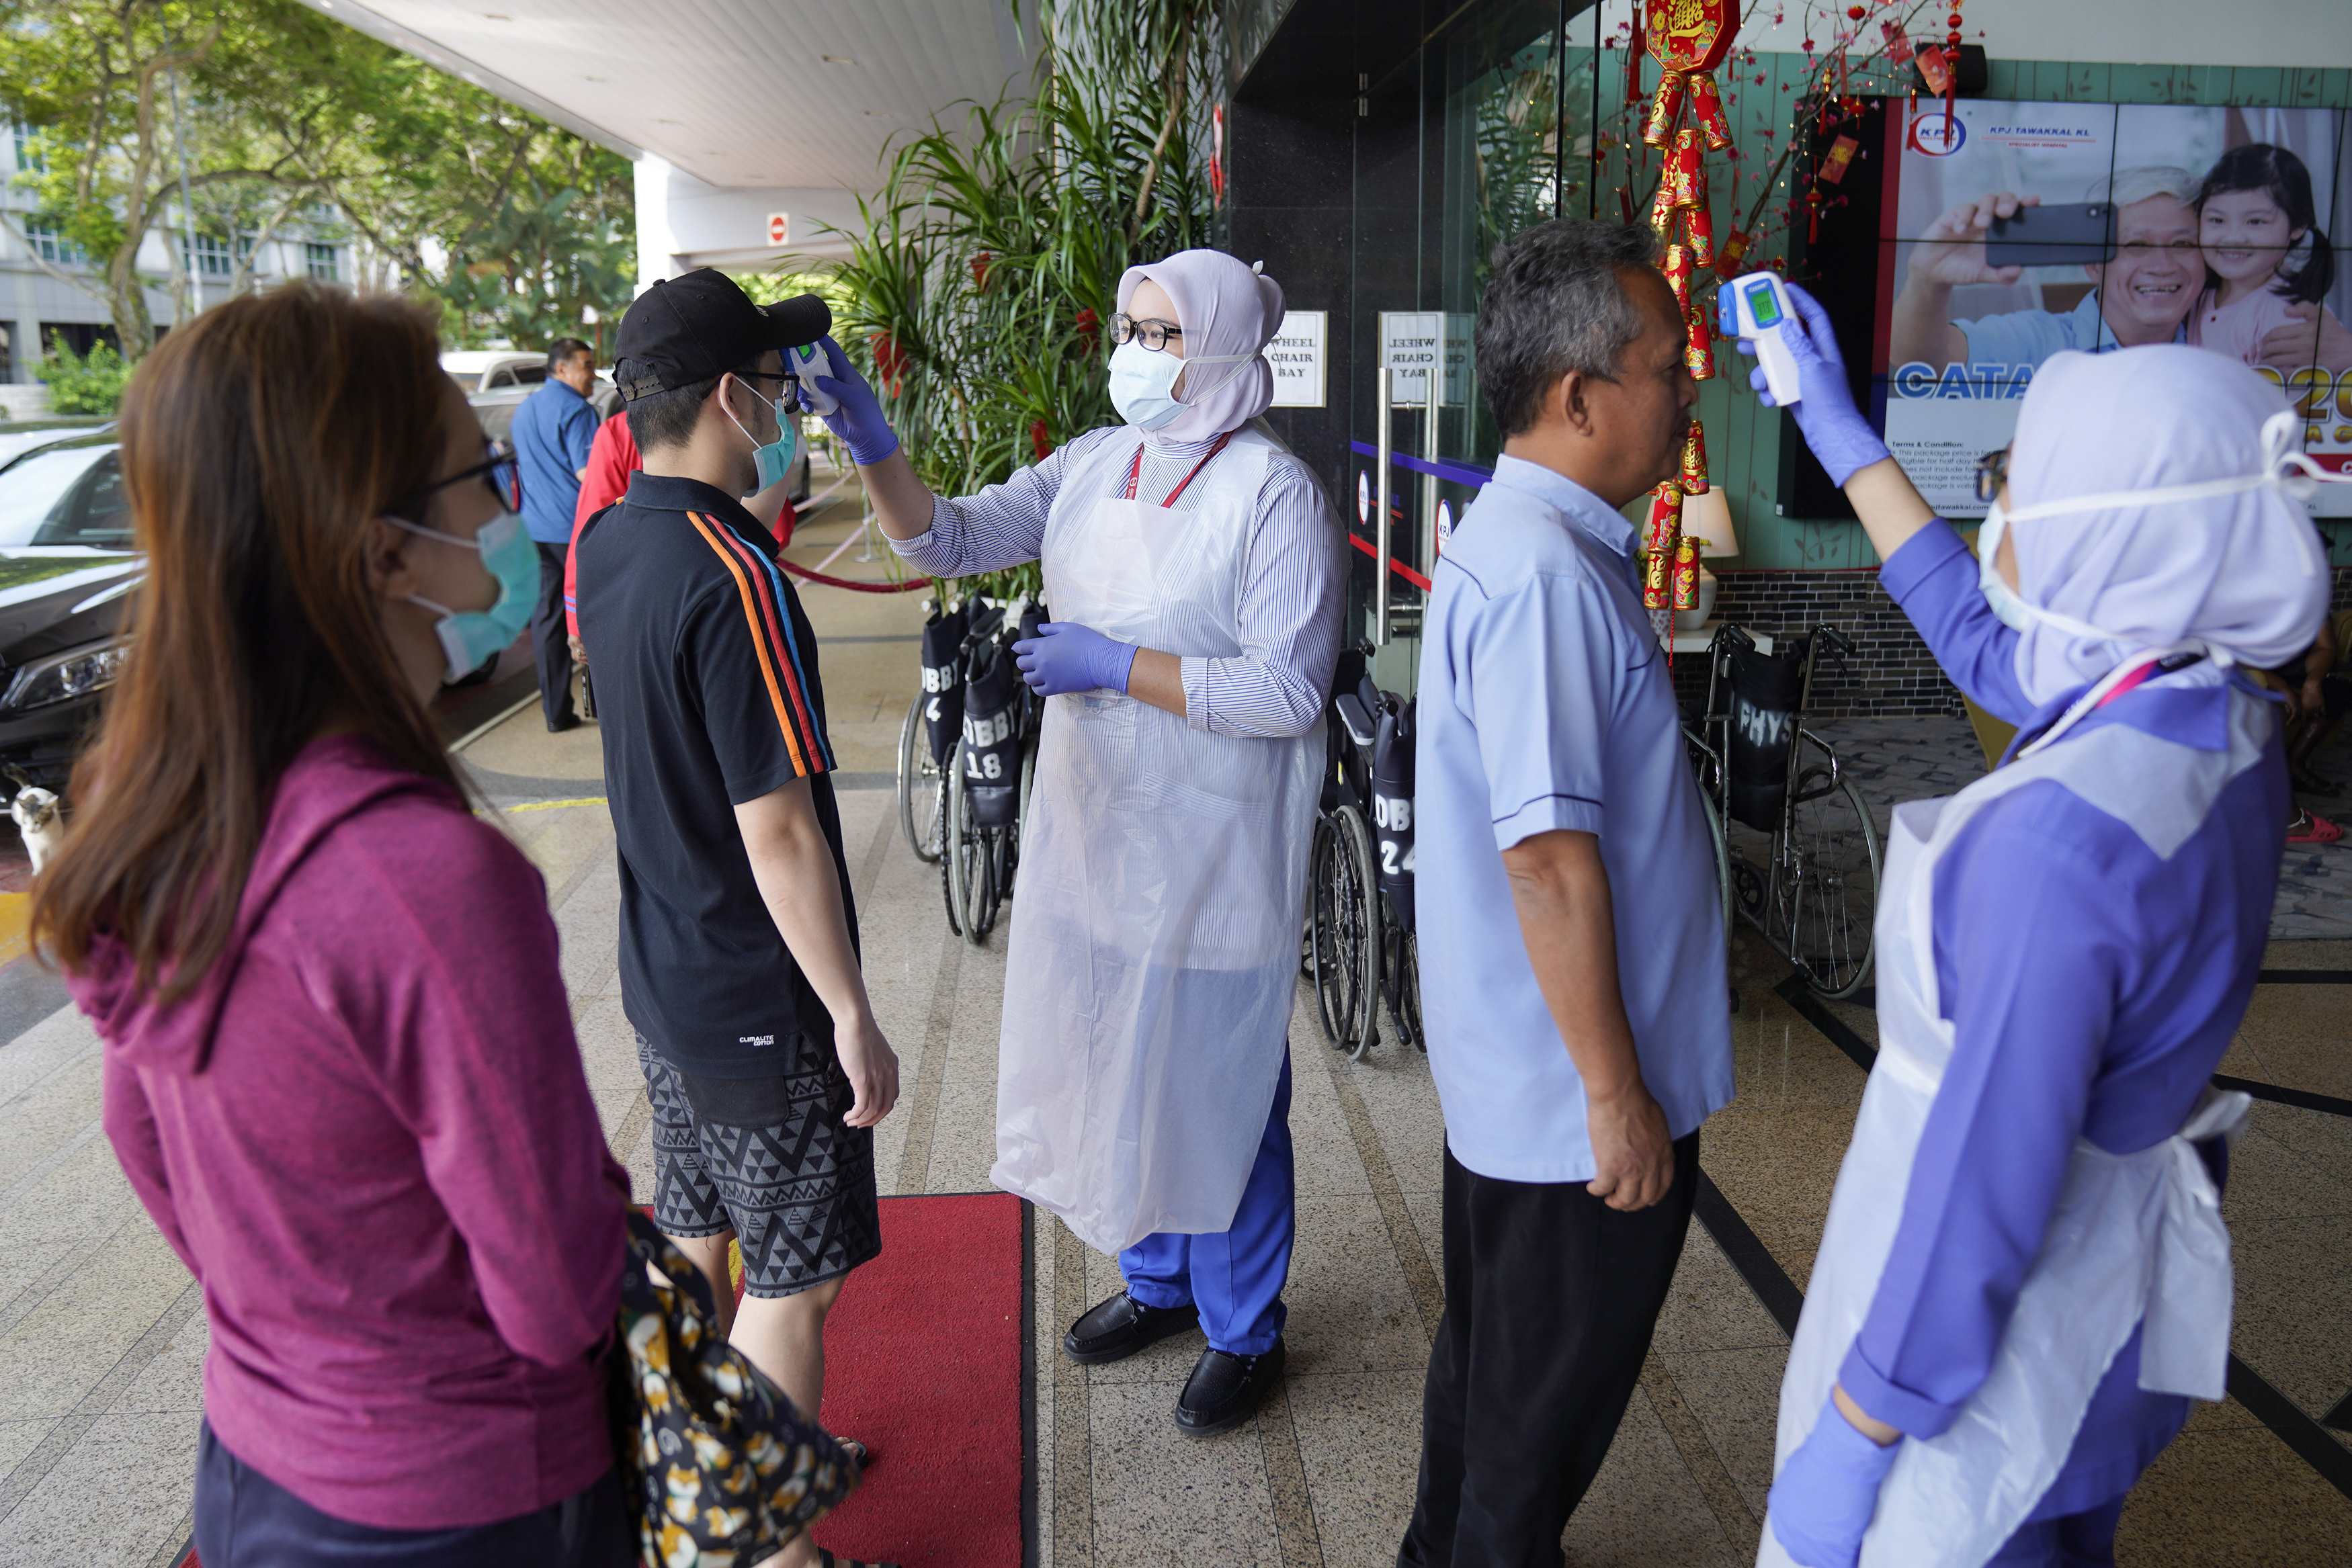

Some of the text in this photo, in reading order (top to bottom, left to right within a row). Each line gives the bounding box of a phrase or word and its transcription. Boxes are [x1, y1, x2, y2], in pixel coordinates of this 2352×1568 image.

[2016, 127, 2072, 136] TAWAKKAL
[2076, 128, 2089, 136] KL
[1271, 353, 1312, 362] CHAIR
[1278, 369, 1305, 377] BAY
[1439, 524, 1450, 537] KPJ
[926, 697, 941, 722] 4
[966, 751, 1002, 779] 18
